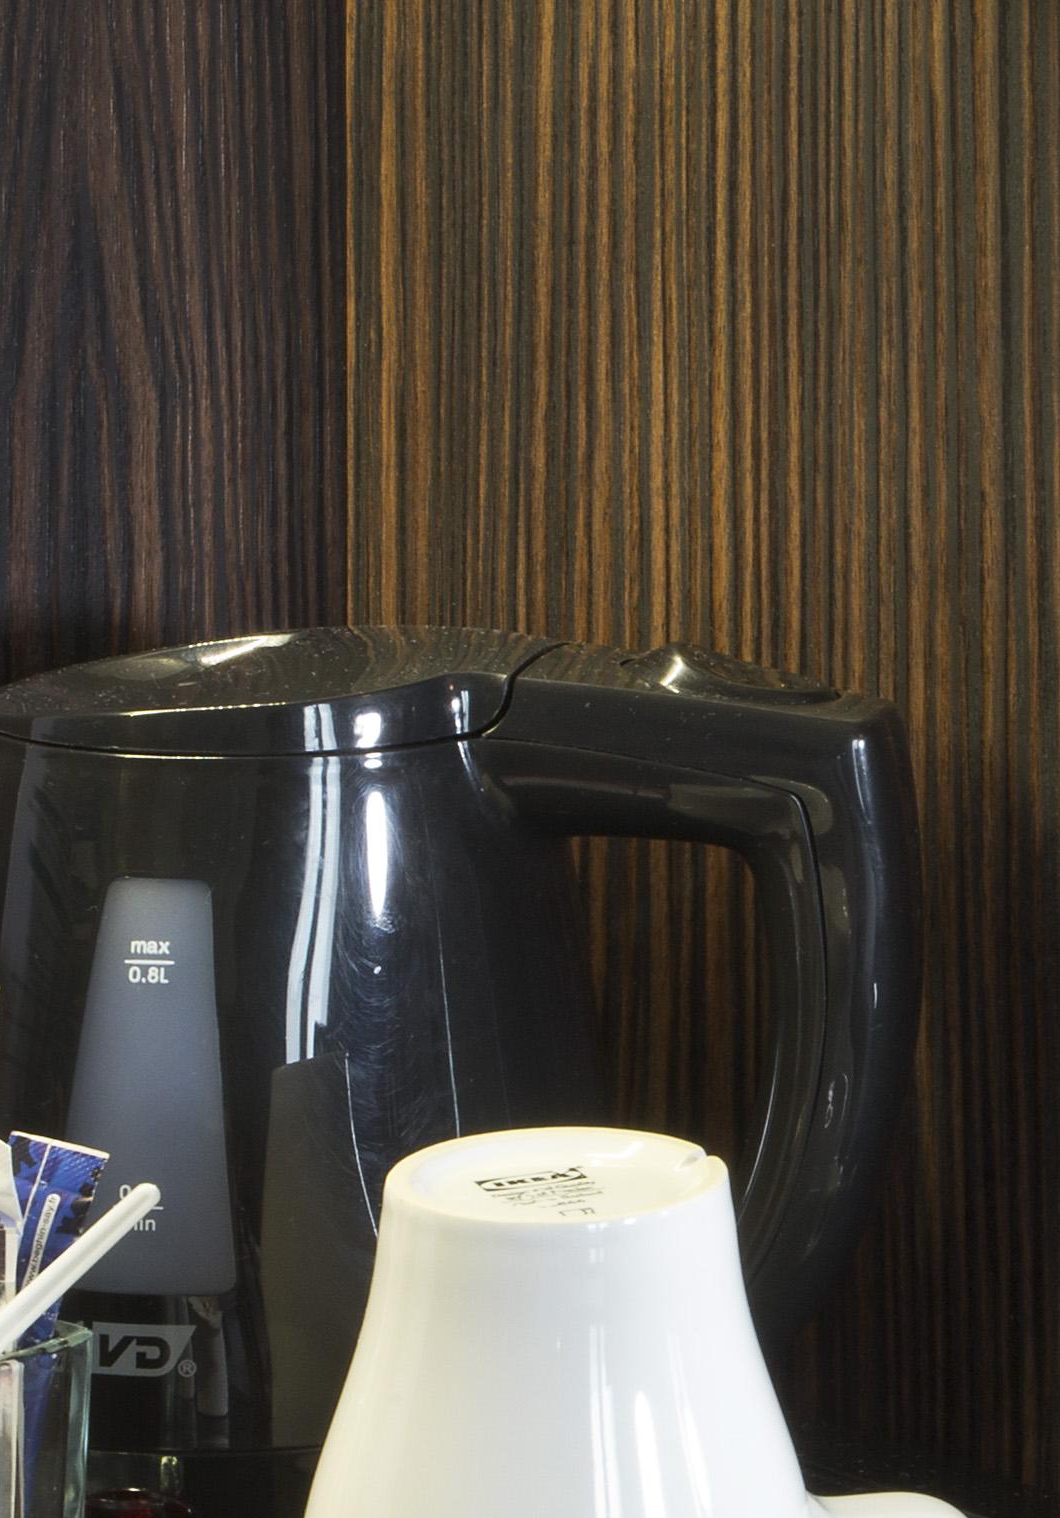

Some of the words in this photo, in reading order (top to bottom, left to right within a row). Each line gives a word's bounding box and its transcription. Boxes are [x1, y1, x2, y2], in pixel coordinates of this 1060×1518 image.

[130, 940, 171, 955] max
[128, 966, 170, 984] 0.8L
[133, 1218, 157, 1232] in
[99, 1333, 172, 1370] VD
